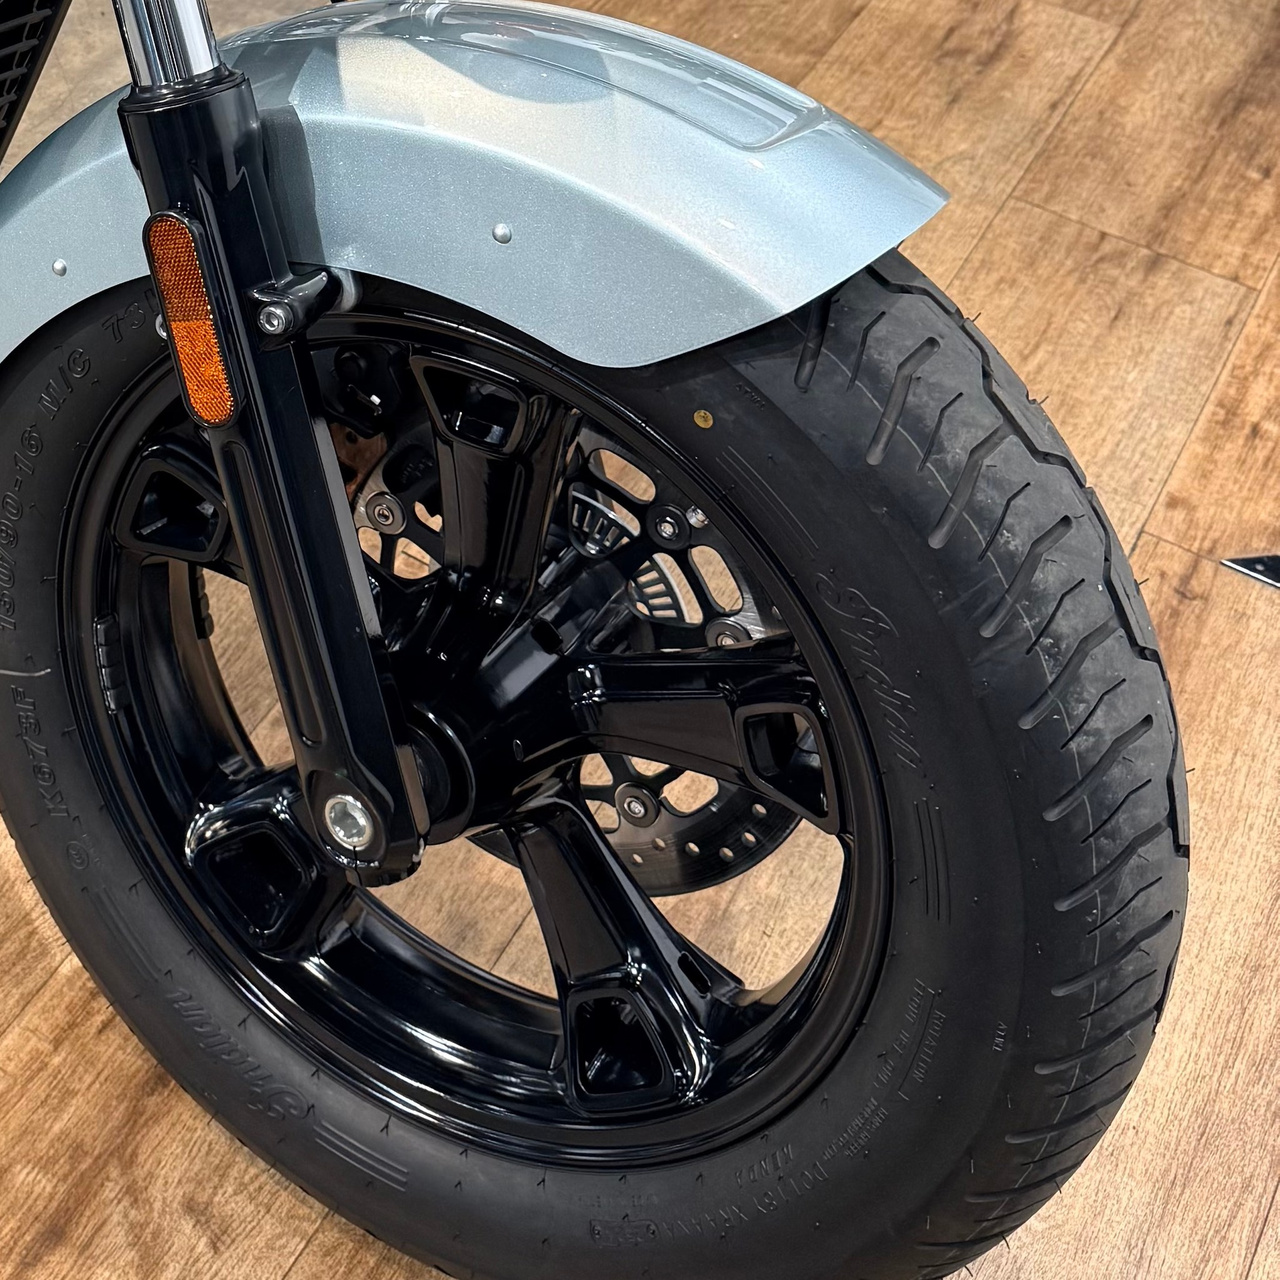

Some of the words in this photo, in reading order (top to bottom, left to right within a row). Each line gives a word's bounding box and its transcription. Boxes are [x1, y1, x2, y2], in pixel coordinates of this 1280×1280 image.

[37, 347, 92, 421] M/C
[10, 684, 70, 818] K673F
[166, 986, 311, 1121] Indian
[735, 1143, 794, 1189] KENDA
